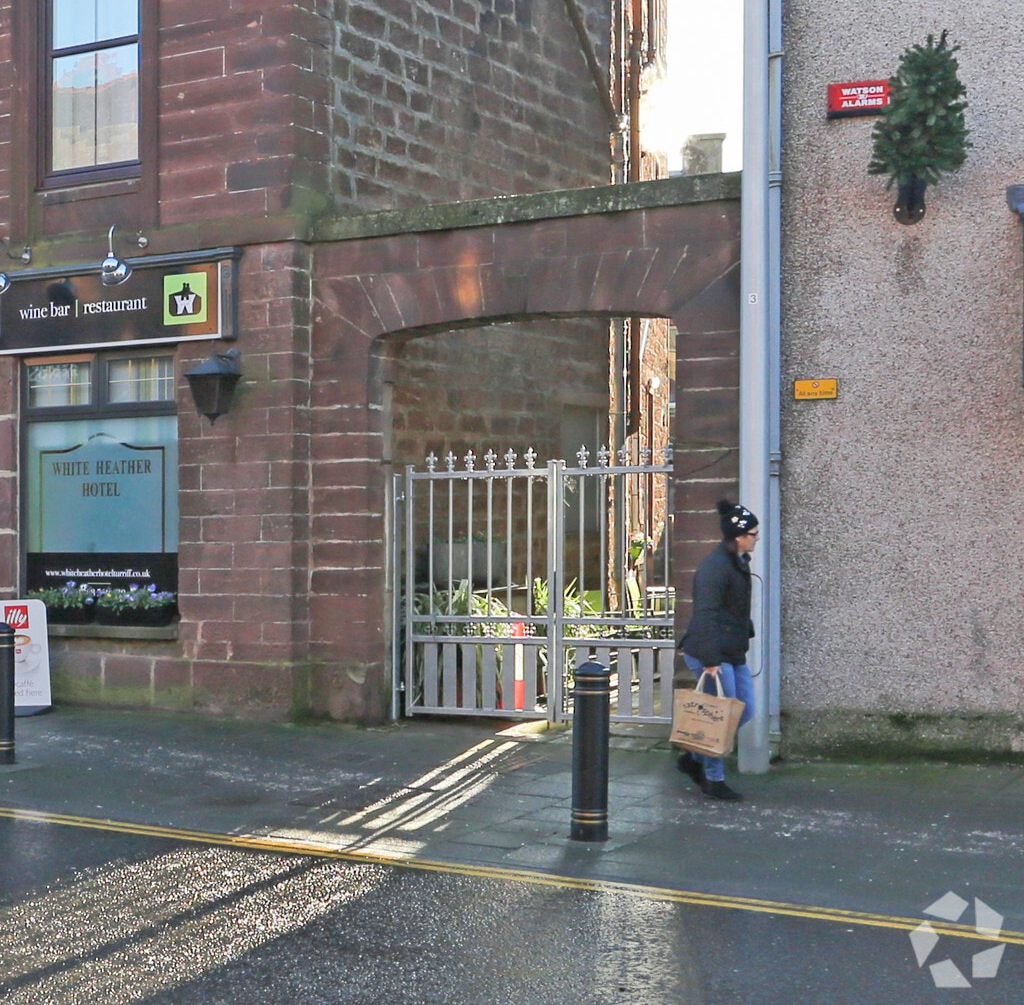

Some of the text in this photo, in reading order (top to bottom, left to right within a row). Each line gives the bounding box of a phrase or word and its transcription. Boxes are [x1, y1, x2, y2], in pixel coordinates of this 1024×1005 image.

[841, 85, 884, 96] WATSON
[841, 98, 883, 108] ALARMS
[750, 294, 757, 304] 3
[19, 296, 147, 320] wine bar restaurant
[52, 459, 152, 476] WHITE HEATHER
[82, 482, 121, 497] HOTEL
[6, 608, 27, 627] illy
